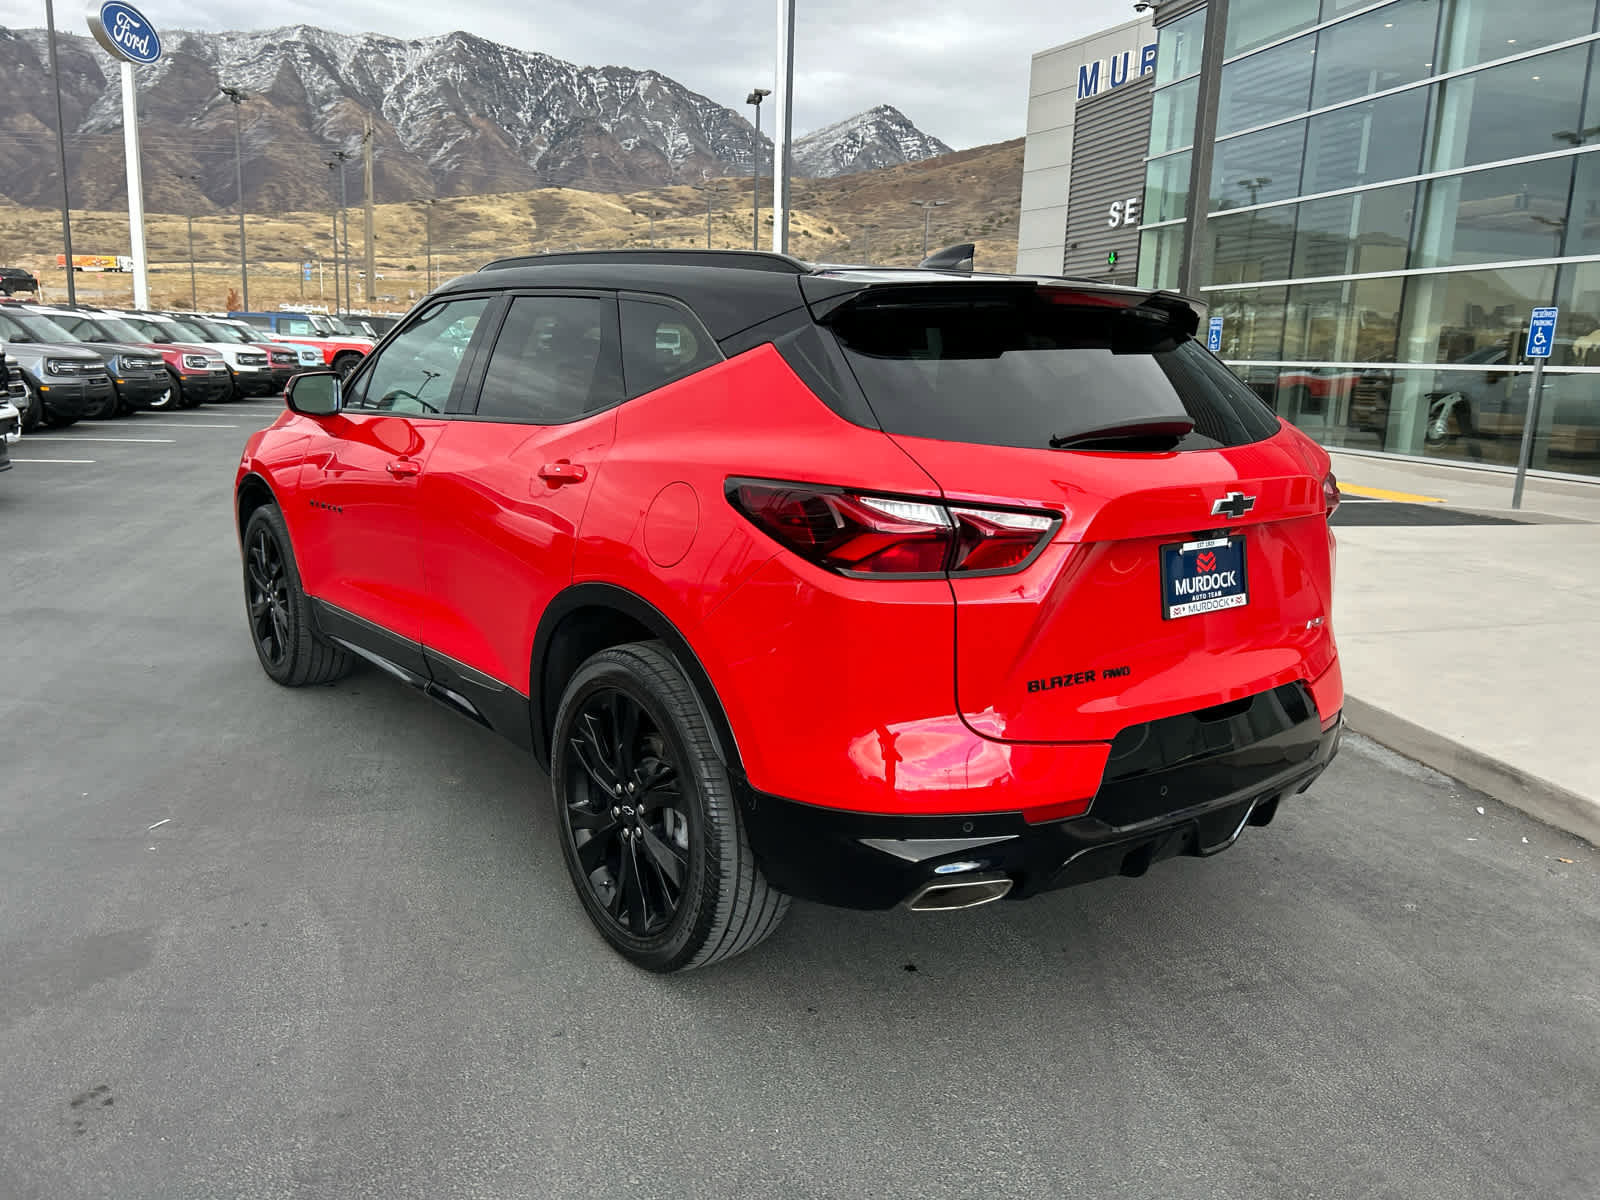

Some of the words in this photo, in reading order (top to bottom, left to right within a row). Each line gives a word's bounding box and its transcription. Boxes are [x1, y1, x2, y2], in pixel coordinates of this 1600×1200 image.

[113, 11, 150, 56] Ford
[1108, 198, 1137, 227] SE
[1531, 346, 1546, 354] ONLY
[1175, 570, 1237, 596] MURDOCK
[1192, 592, 1207, 602] AUTO
[1208, 590, 1222, 599] TEAM
[1188, 597, 1230, 614] MURDOCK
[1027, 670, 1096, 693] BLAZER
[1103, 665, 1131, 680] AWD
